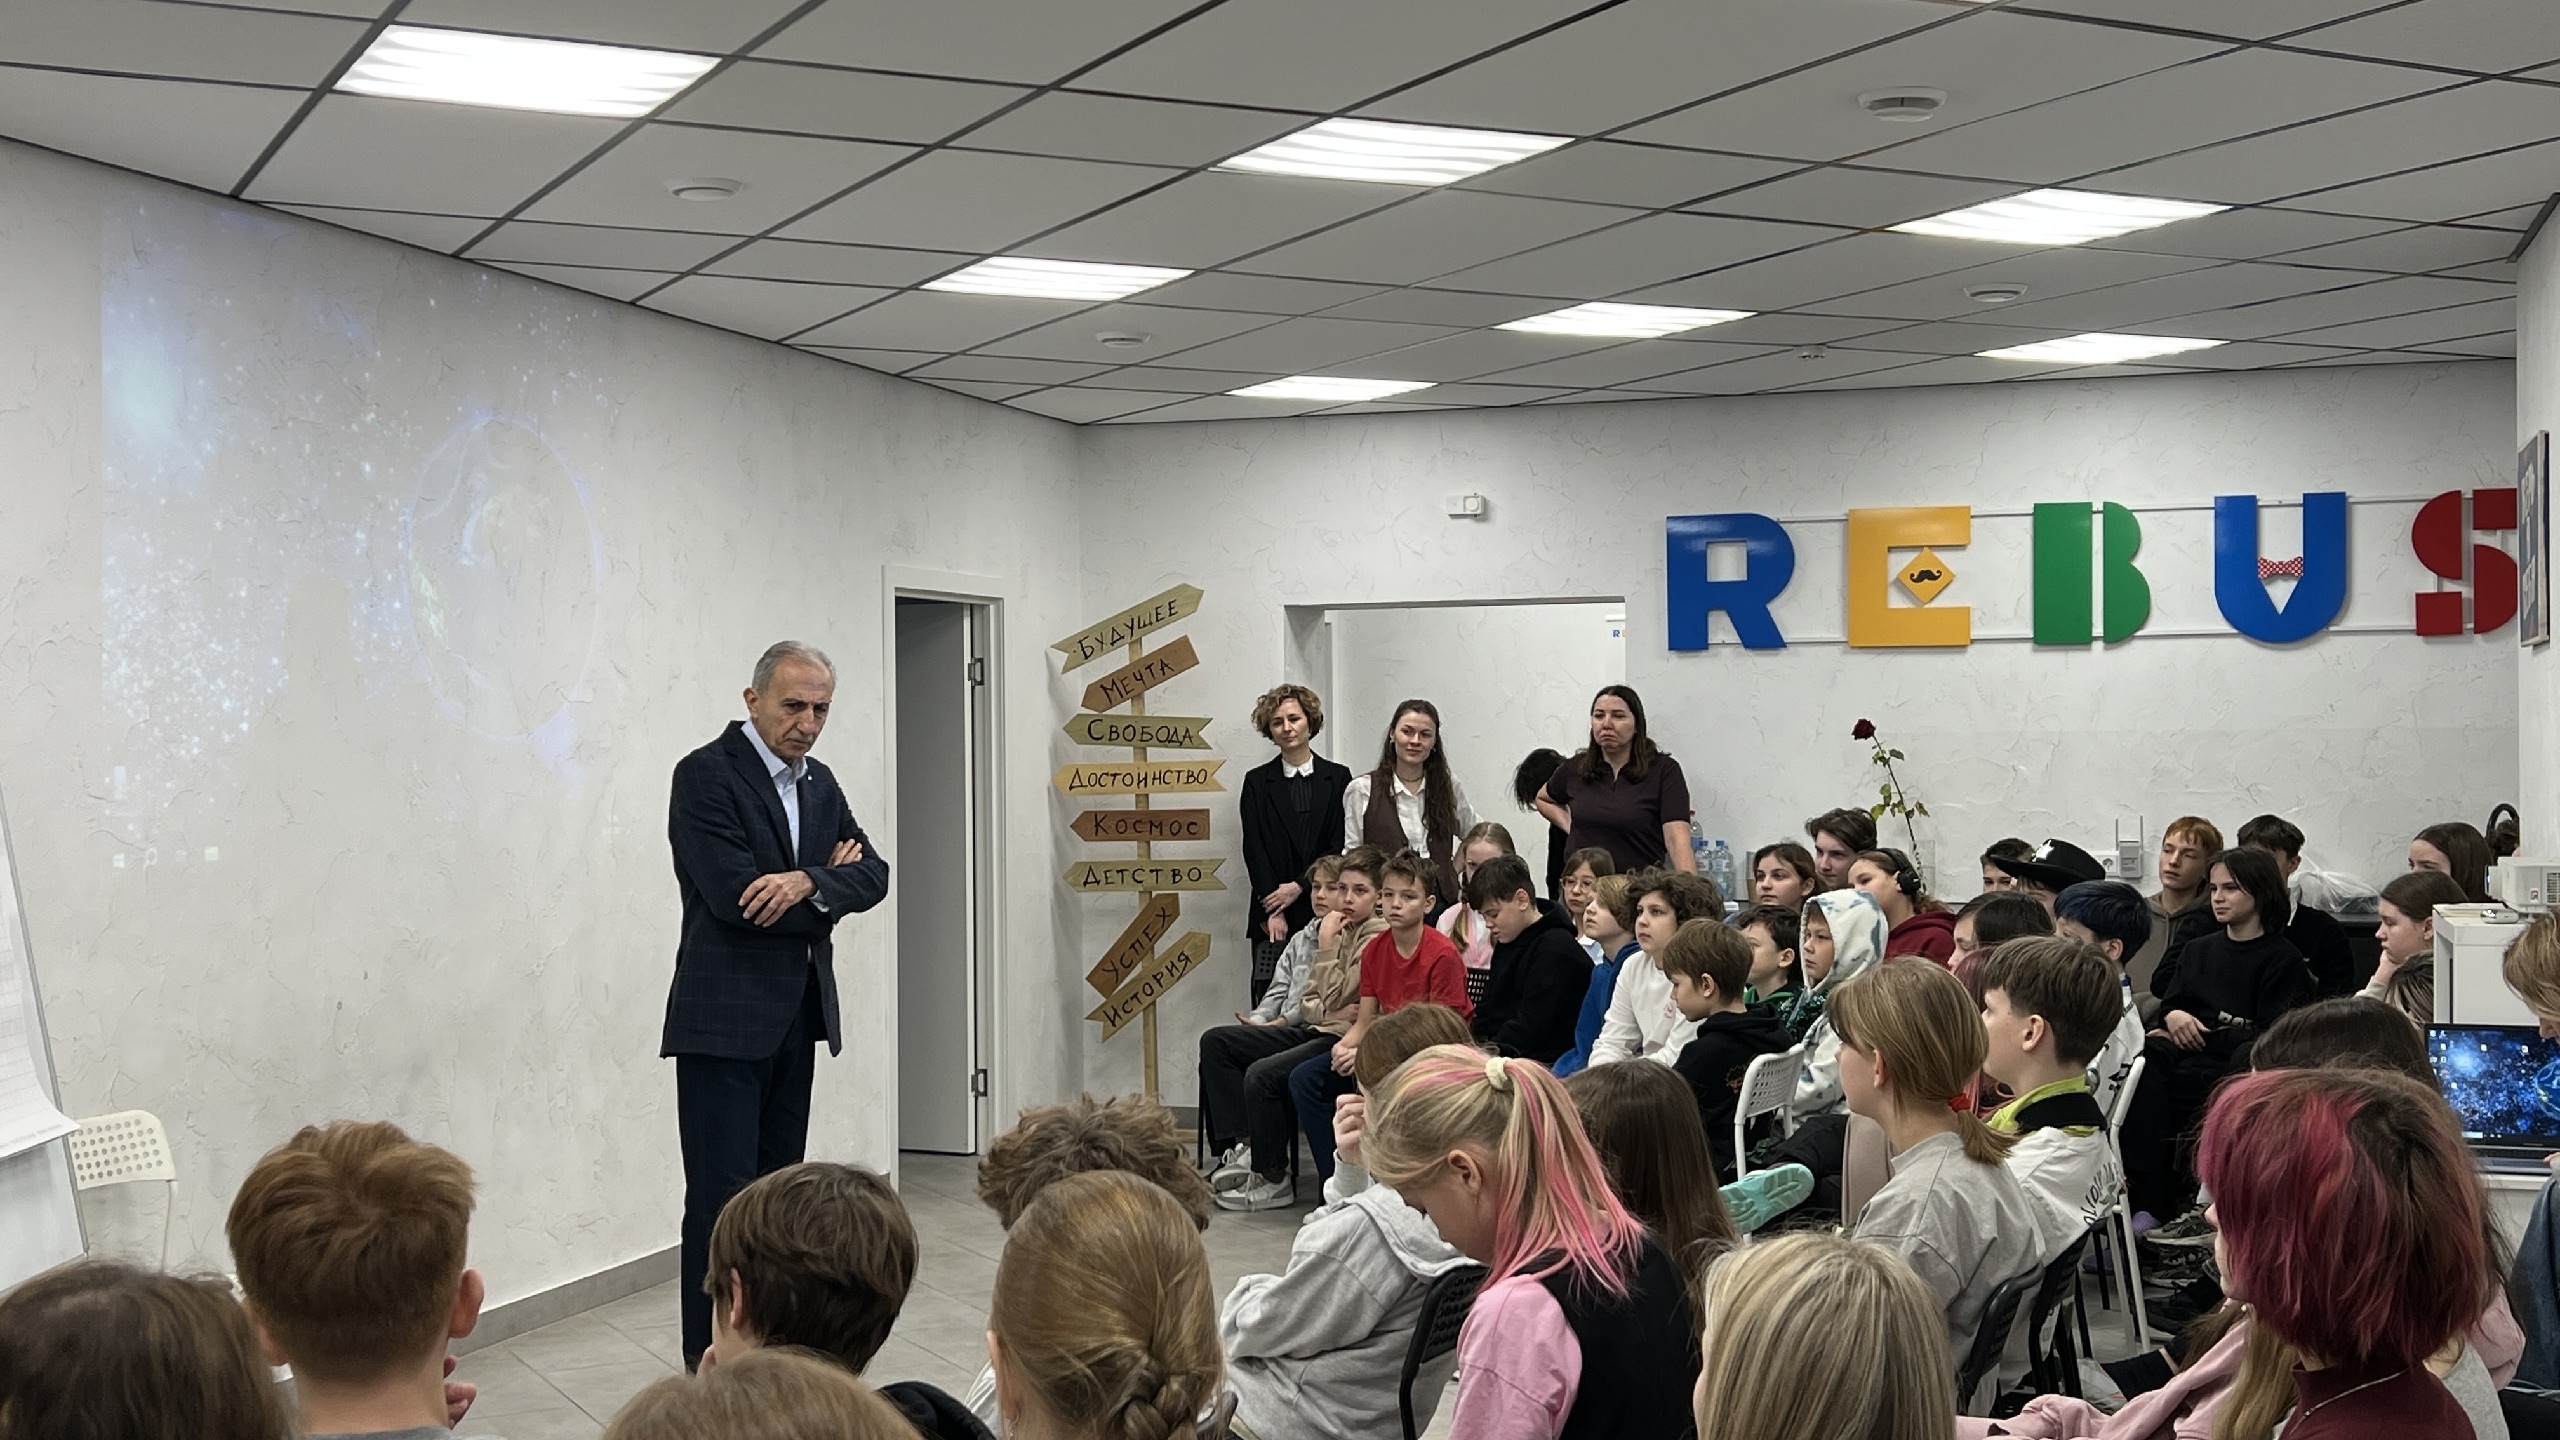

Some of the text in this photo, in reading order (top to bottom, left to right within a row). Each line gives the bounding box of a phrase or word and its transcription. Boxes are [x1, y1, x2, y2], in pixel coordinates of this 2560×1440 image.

[1666, 488, 2518, 650] REBUS
[1102, 906, 1172, 984] УСПЕХ
[1103, 950, 1192, 1027] ИСТОРИЯ
